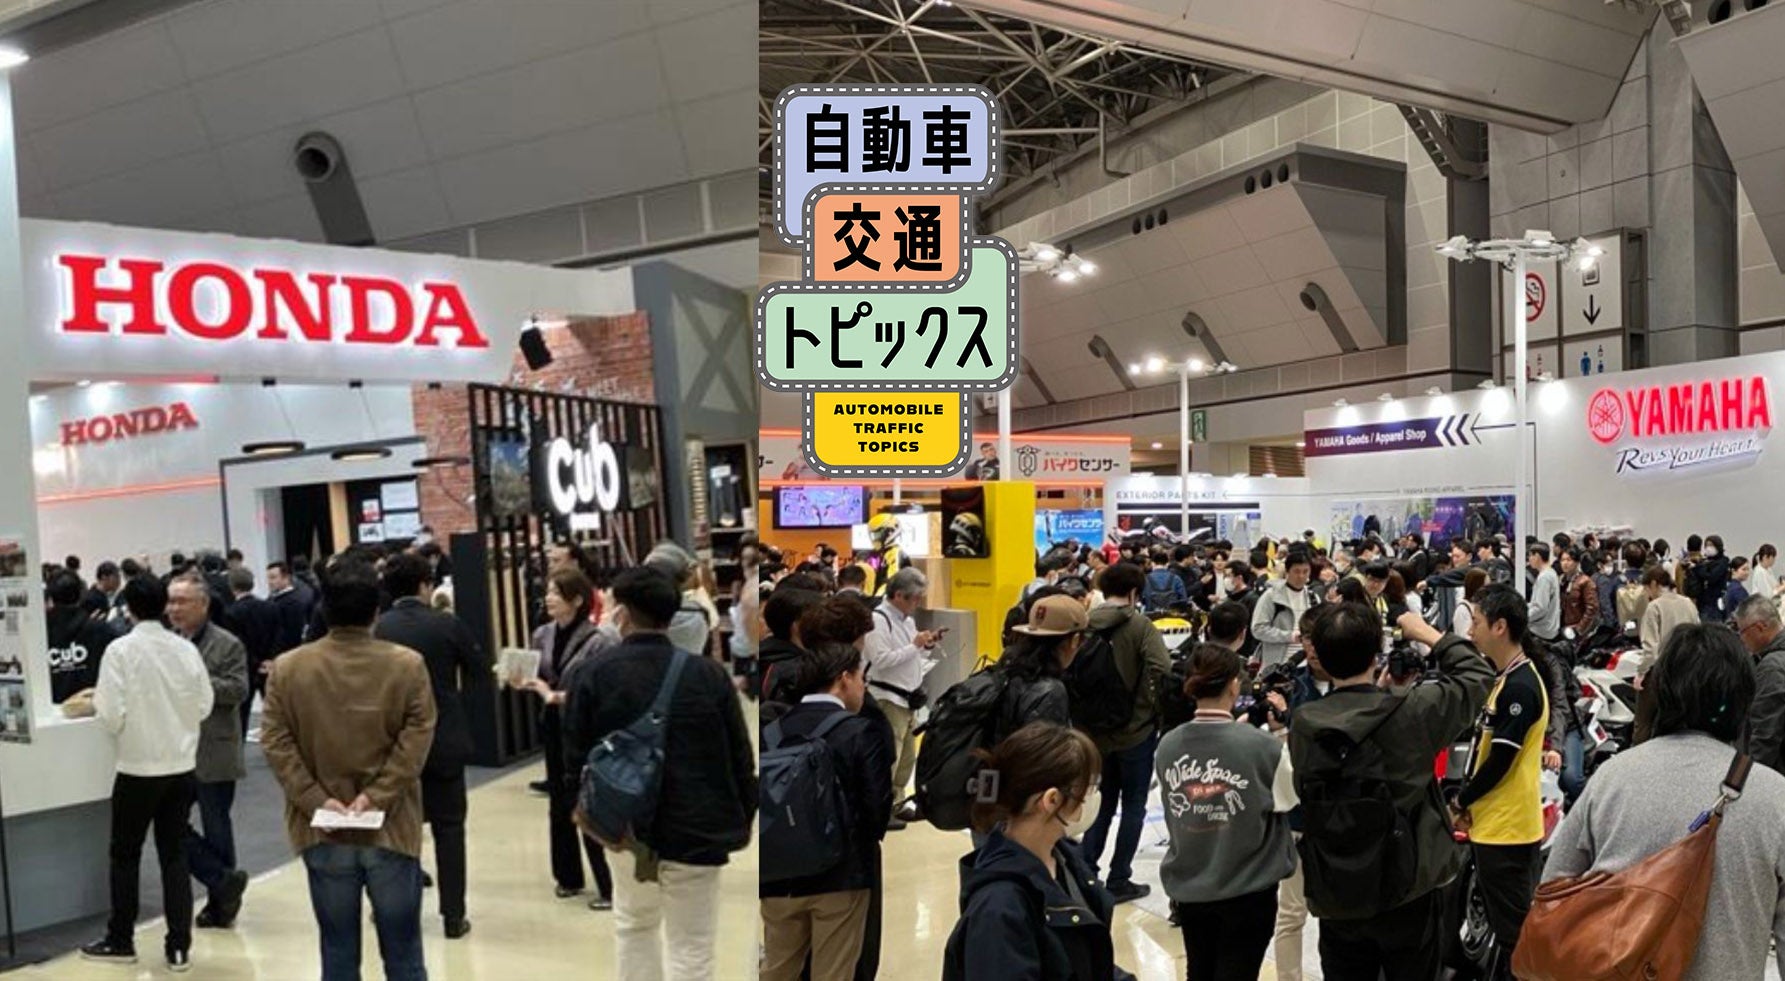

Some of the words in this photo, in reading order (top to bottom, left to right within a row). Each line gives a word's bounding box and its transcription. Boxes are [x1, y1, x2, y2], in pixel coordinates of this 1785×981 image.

[58, 254, 489, 349] HONDA
[60, 402, 197, 446] HONDA
[1625, 376, 1771, 437] YAMAHA
[1313, 436, 1344, 448] YAMAHA
[1345, 434, 1369, 446] Goods
[1375, 429, 1404, 445] Apparel
[1405, 428, 1427, 443] Shop
[1167, 491, 1199, 500] PATS
[1165, 754, 1202, 791] Wide
[1201, 758, 1249, 789] Space
